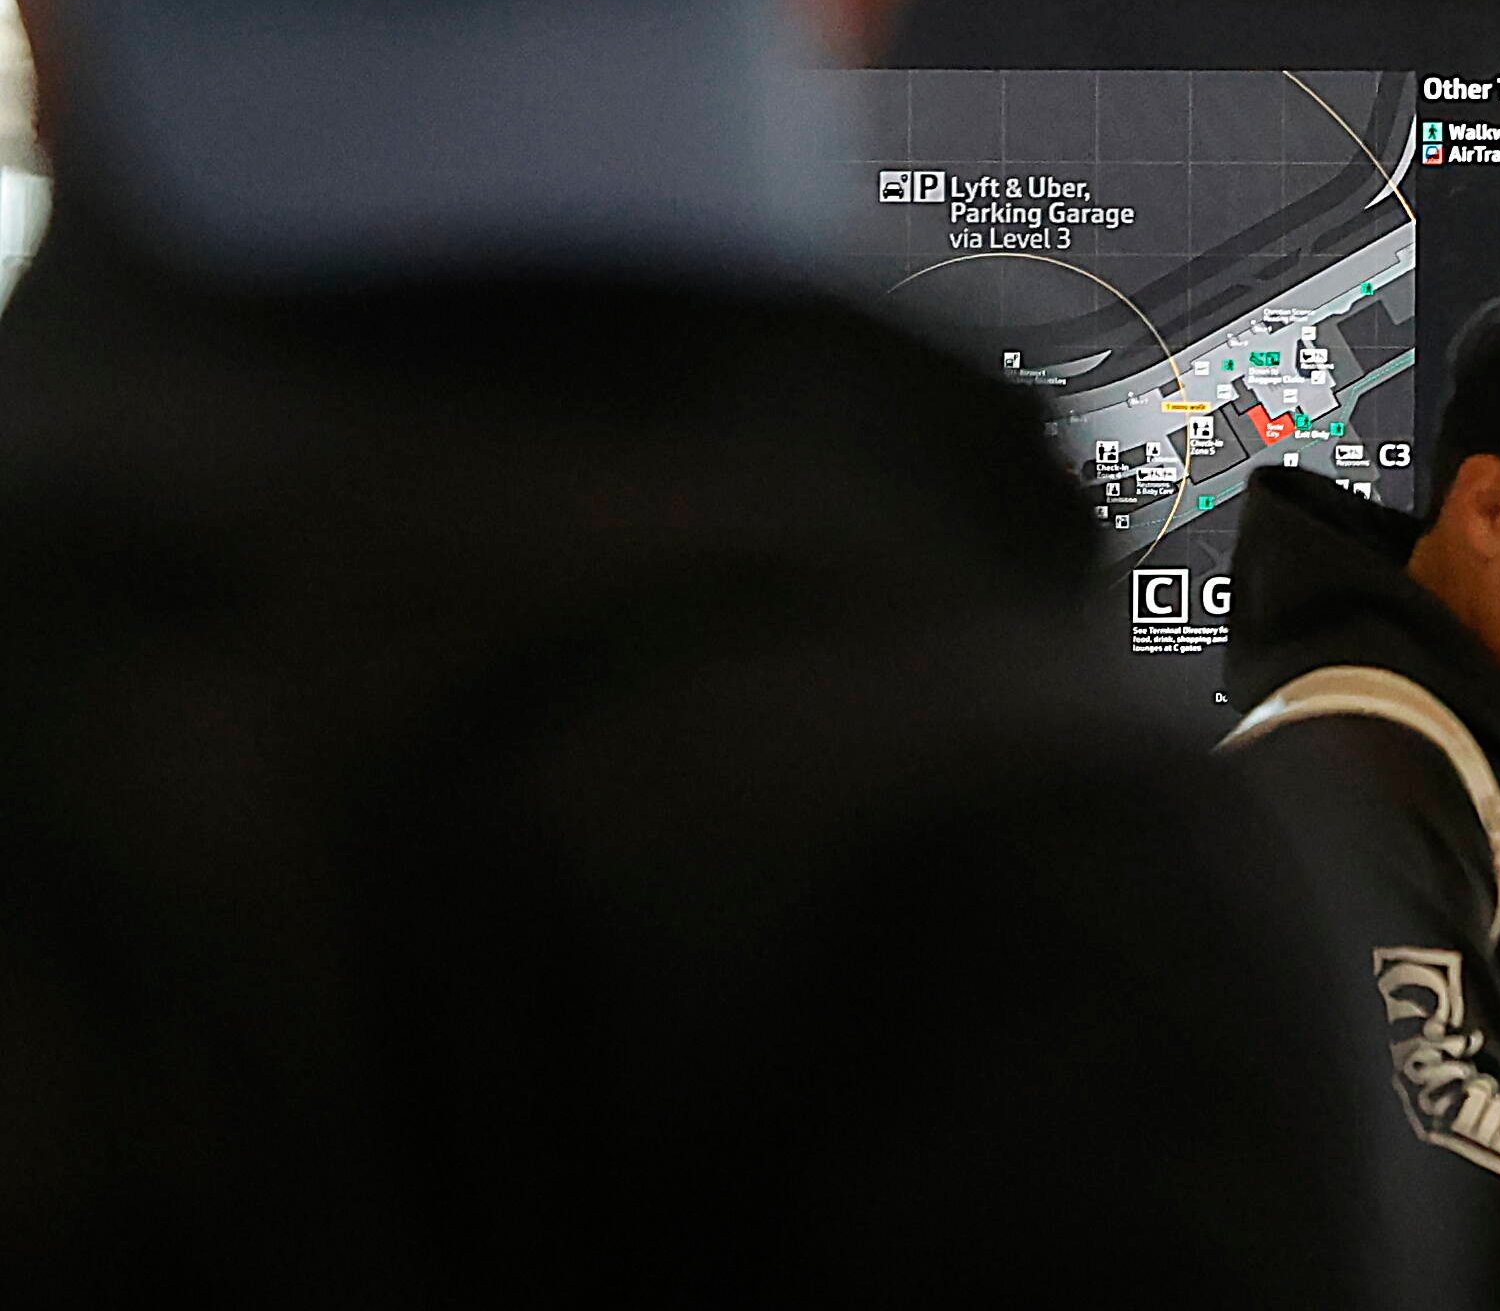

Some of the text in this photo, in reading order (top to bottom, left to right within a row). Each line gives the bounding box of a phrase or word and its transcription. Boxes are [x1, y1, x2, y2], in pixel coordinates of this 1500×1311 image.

[1423, 77, 1493, 100] Other
[951, 176, 1091, 206] Lyft & Uber,
[951, 199, 1135, 230] Parking Garage
[1379, 443, 1411, 467] C3
